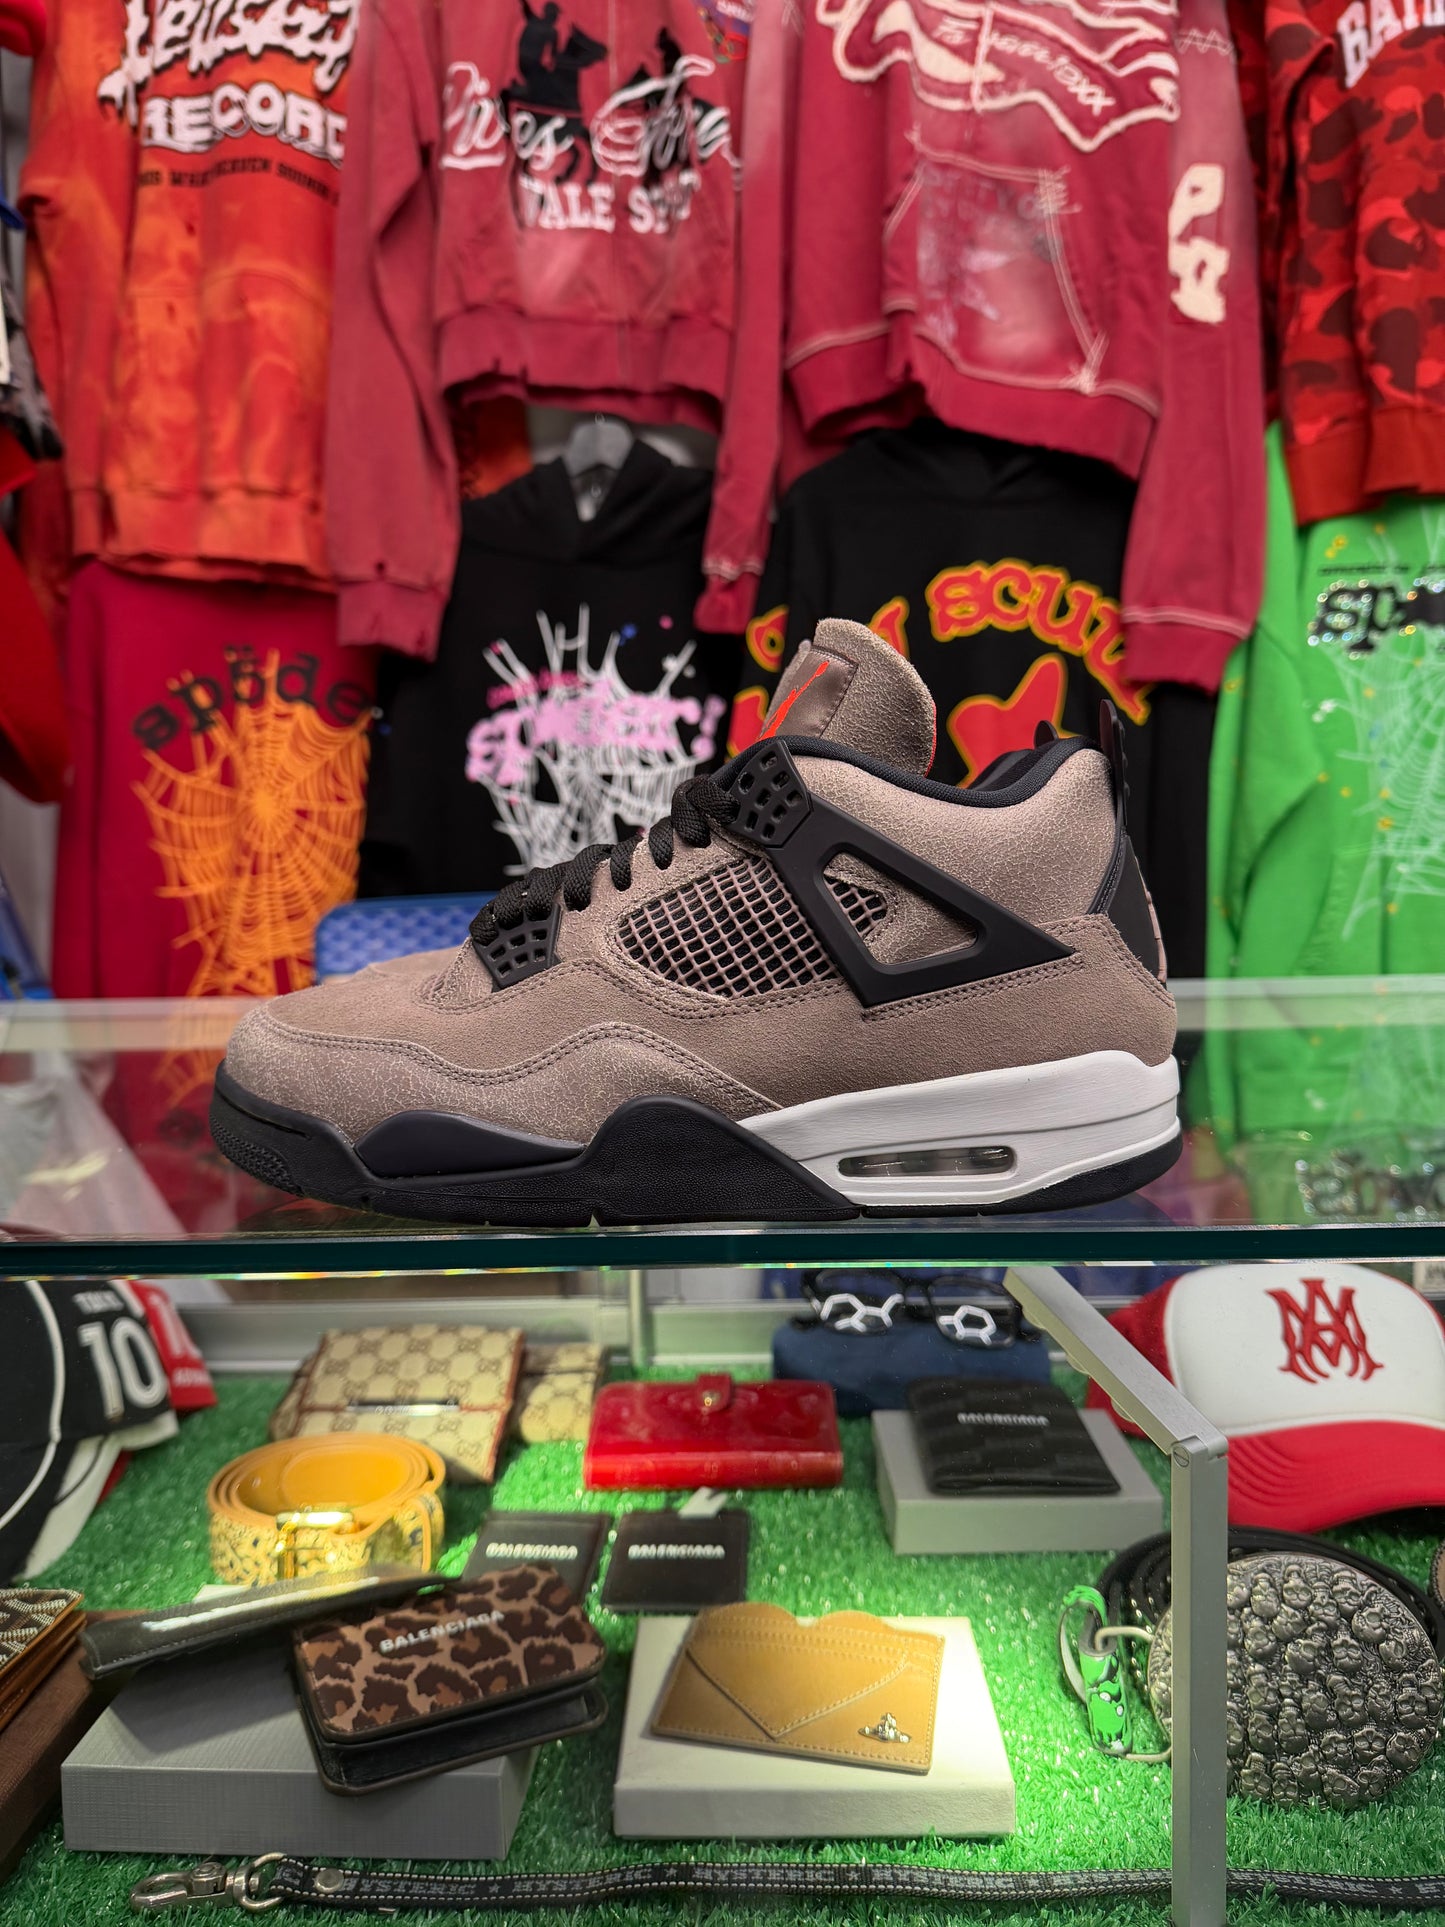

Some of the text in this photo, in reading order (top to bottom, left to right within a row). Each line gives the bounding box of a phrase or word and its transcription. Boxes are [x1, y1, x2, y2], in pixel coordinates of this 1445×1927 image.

[78, 1316, 168, 1420] 10
[379, 1609, 505, 1653] BALENCIAGA
[692, 1866, 835, 1882] HYSTERIC
